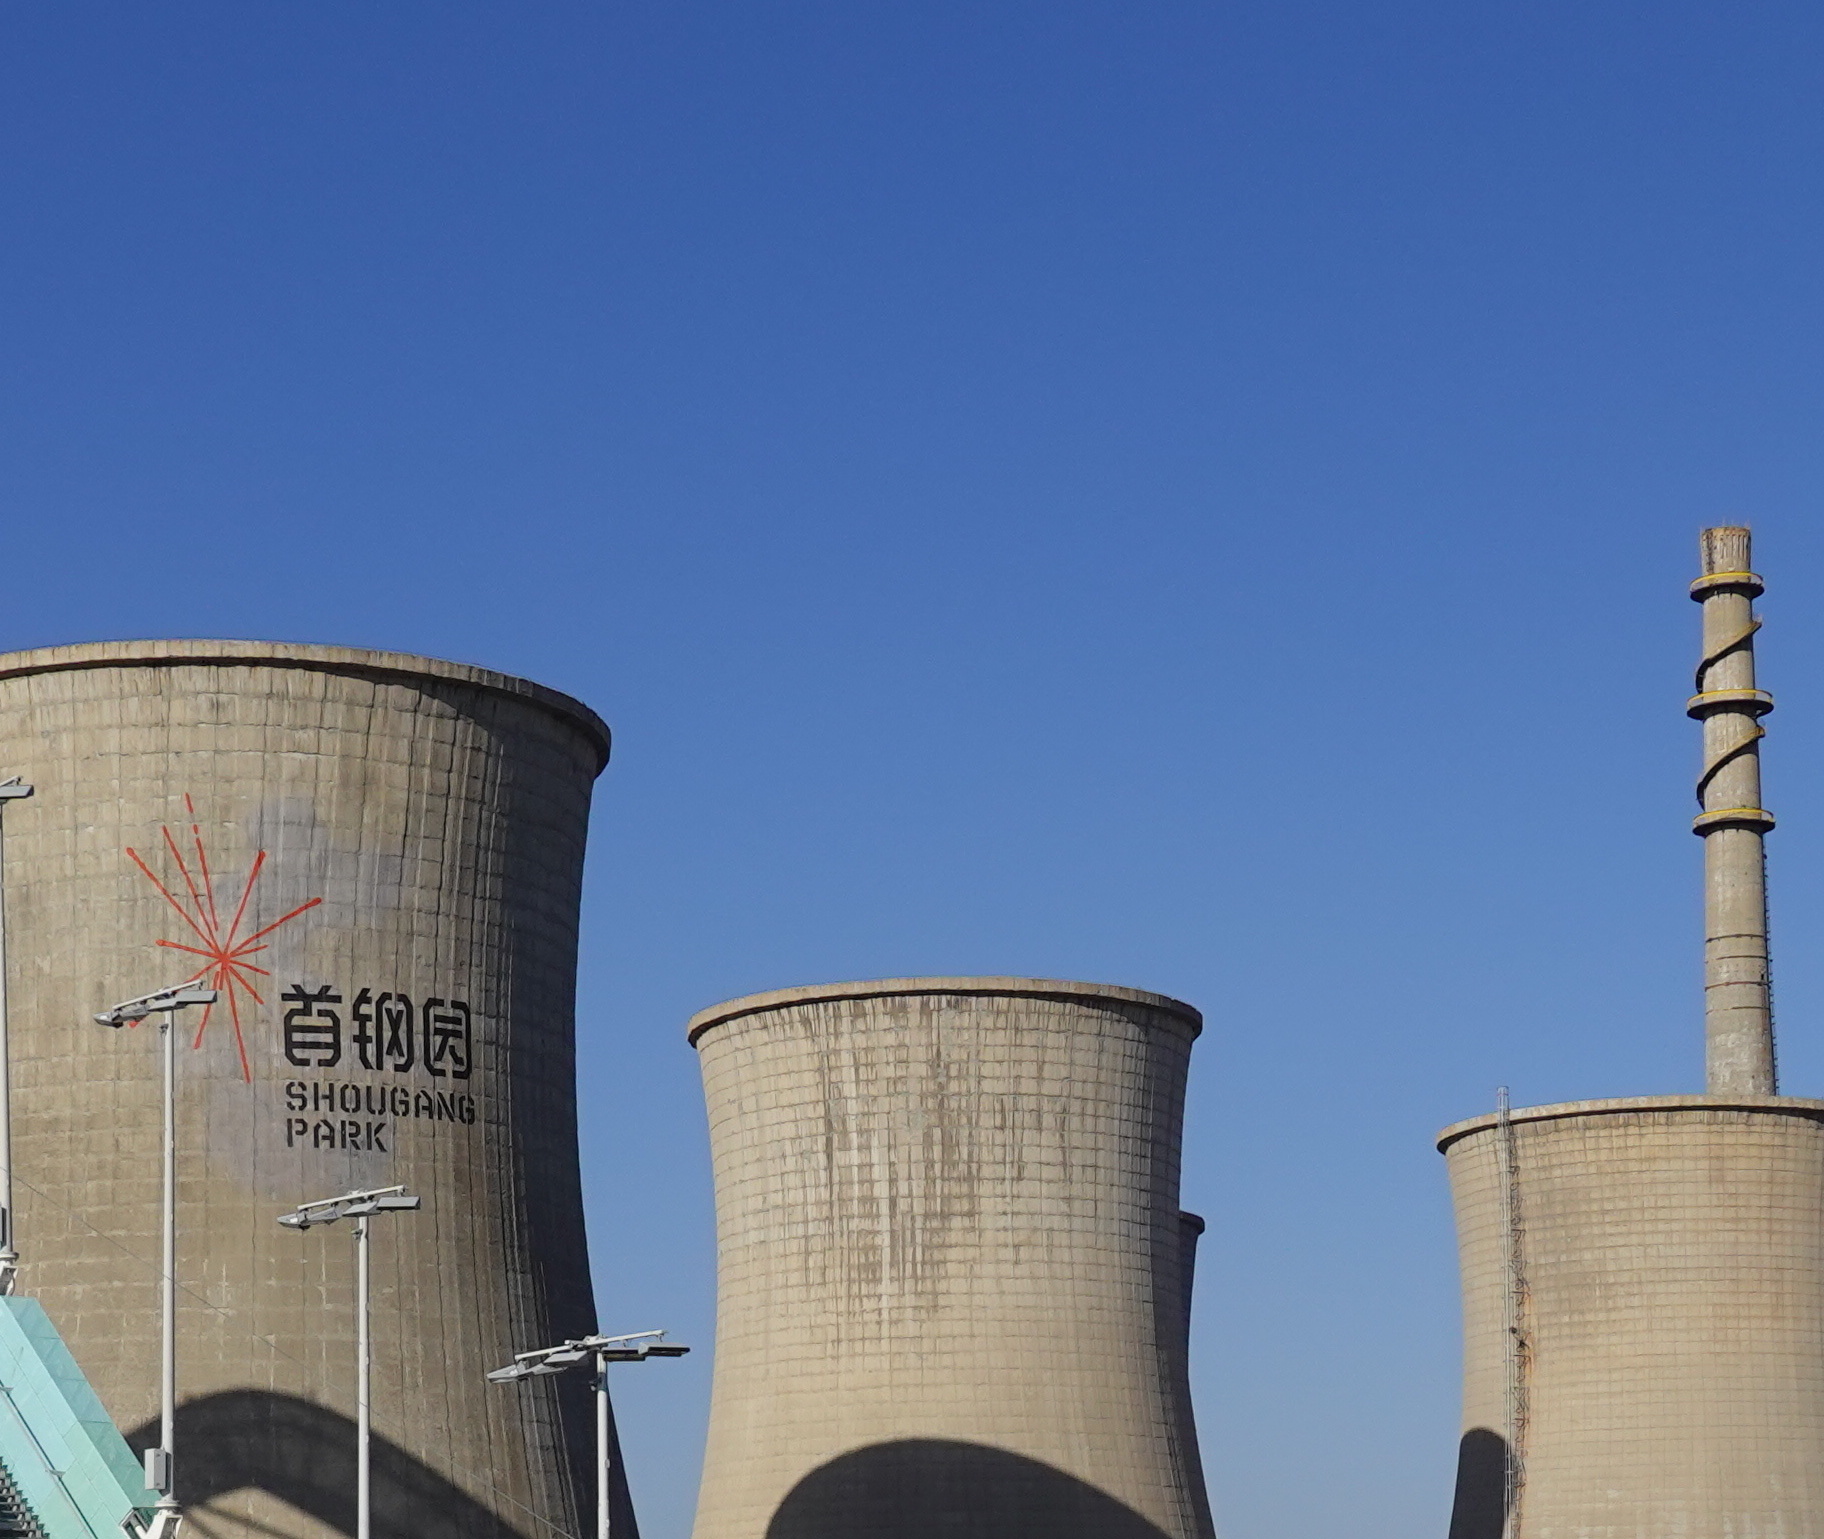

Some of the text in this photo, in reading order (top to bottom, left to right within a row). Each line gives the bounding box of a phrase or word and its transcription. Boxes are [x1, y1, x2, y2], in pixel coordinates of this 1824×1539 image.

[280, 983, 473, 1080] 首钢园
[285, 1081, 476, 1126] SHOUGANG
[286, 1117, 389, 1153] PARK
